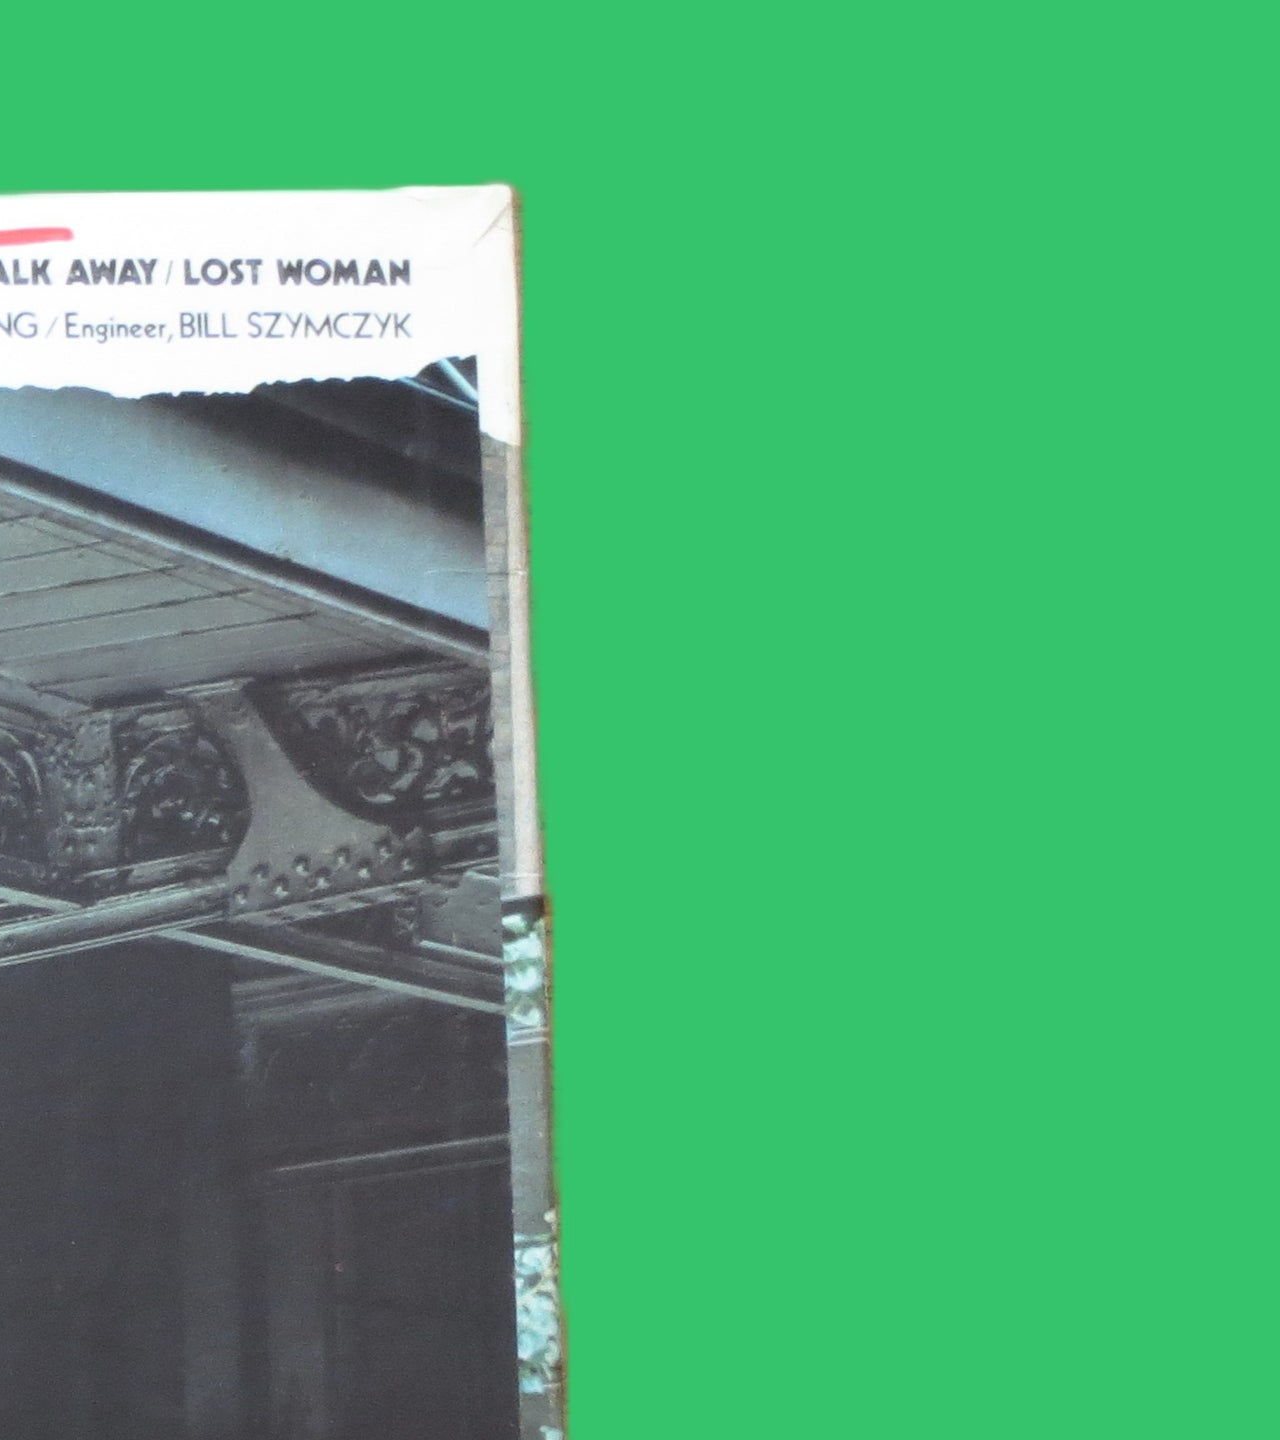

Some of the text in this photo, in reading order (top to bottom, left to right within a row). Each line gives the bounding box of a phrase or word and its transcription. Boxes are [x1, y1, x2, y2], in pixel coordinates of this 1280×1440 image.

[65, 257, 159, 286] AWAY
[183, 257, 264, 287] LOST
[276, 257, 412, 287] WOMAN
[64, 311, 174, 344] Engineer,
[179, 311, 238, 339] BILL
[247, 311, 413, 339] SZYMCZYK
